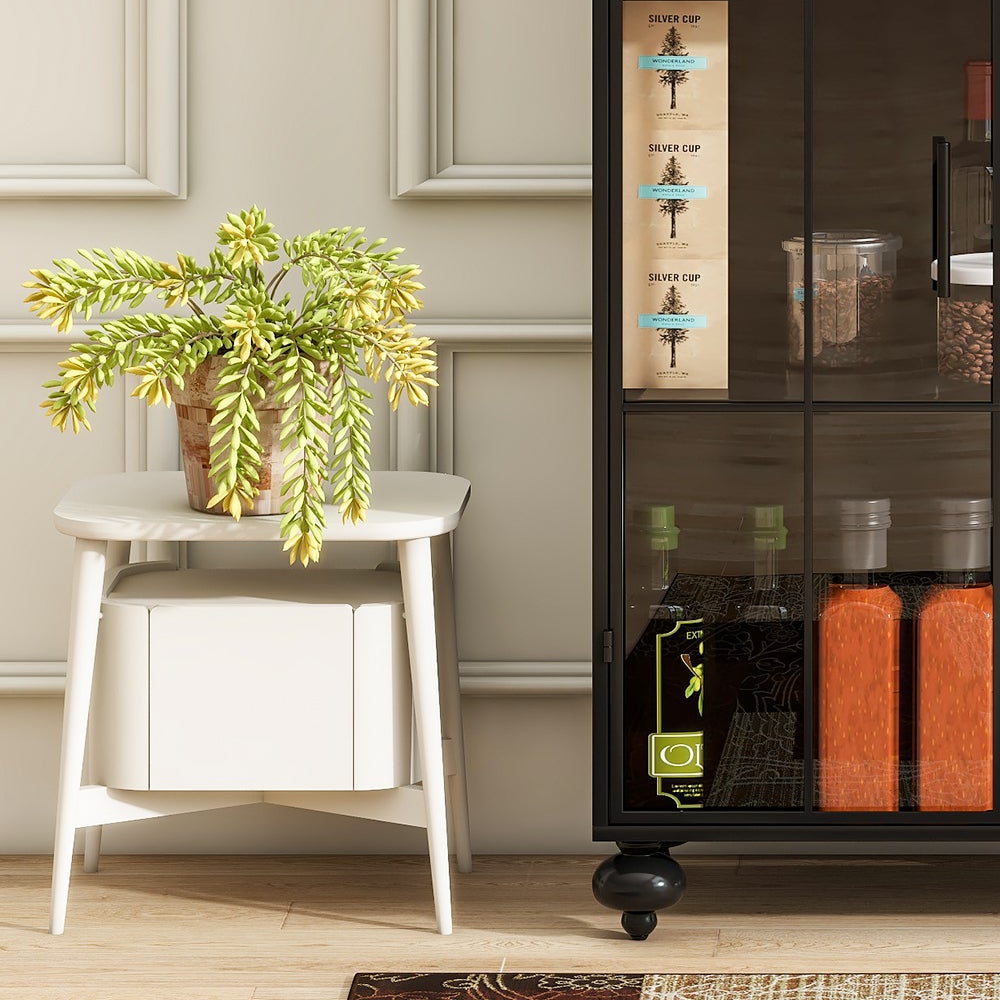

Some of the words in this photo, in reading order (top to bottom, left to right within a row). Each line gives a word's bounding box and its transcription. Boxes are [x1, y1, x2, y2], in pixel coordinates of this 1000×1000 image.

[648, 14, 679, 23] SILVER
[682, 14, 701, 23] CUP
[648, 144, 679, 152] SILVER
[682, 144, 701, 152] CUP
[648, 273, 679, 282] SILVER
[682, 273, 701, 282] CUP
